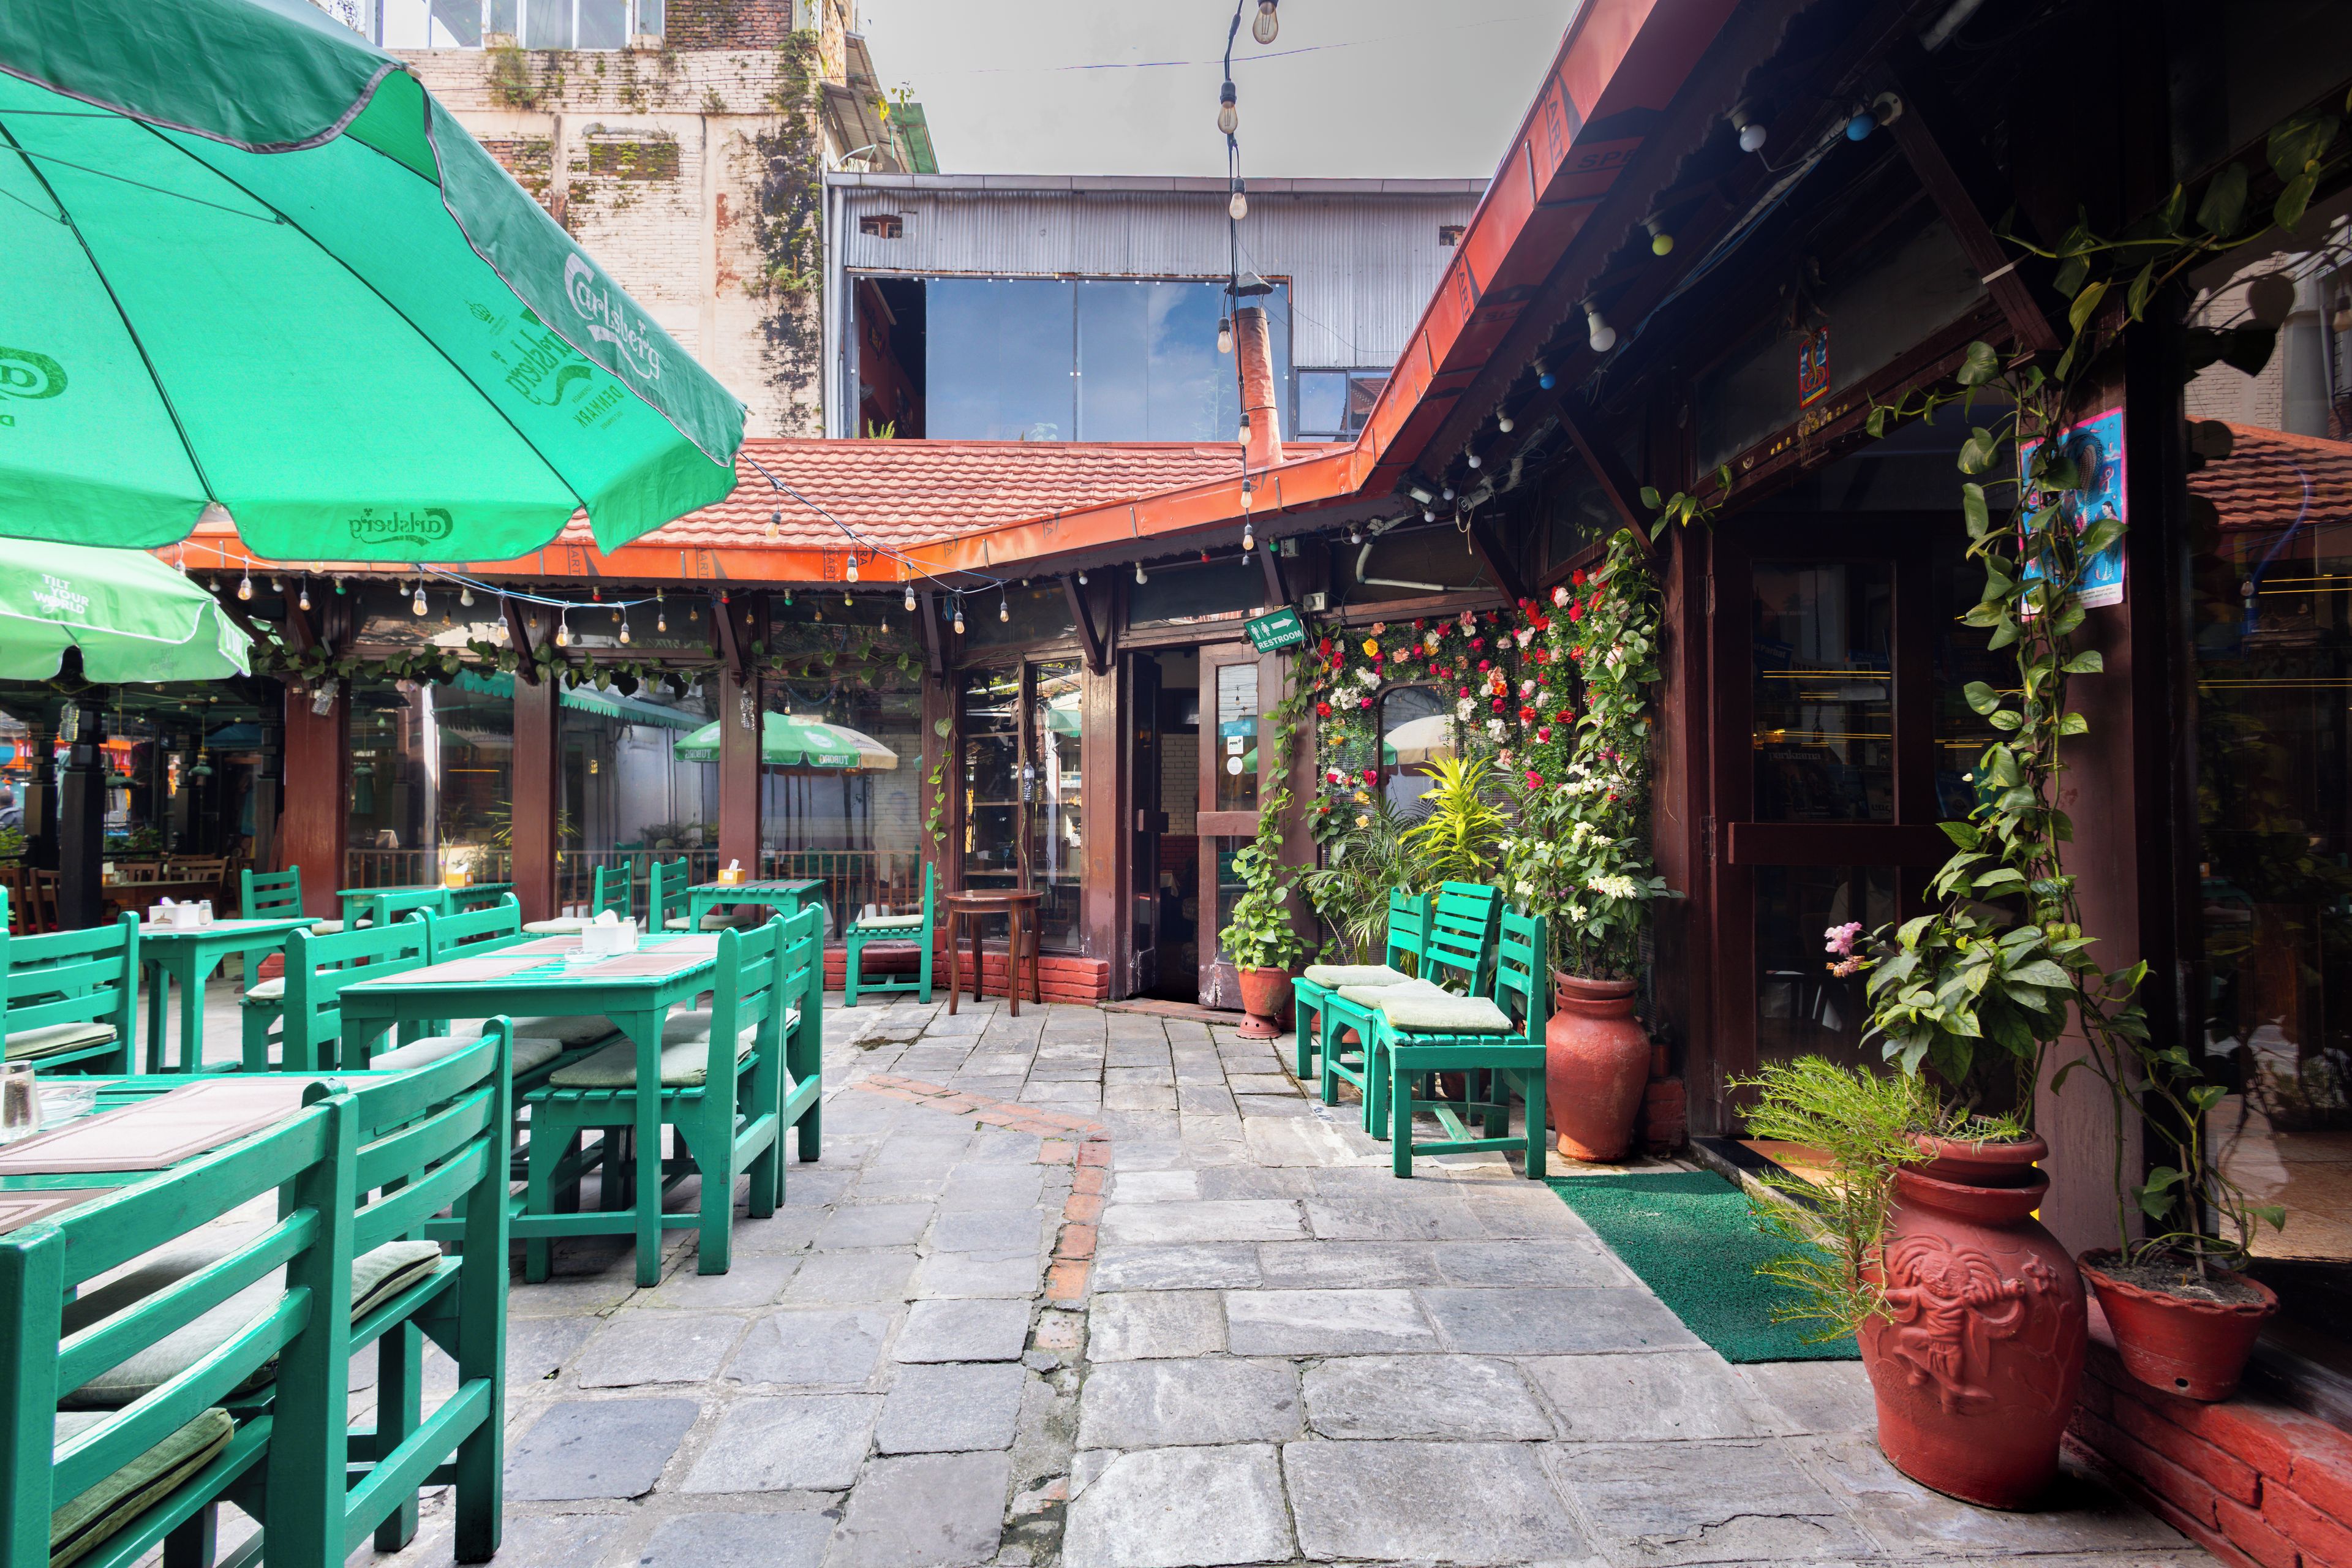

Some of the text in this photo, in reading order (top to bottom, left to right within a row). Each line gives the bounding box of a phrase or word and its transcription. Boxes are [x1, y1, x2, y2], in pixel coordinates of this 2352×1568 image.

[564, 252, 661, 380] Carlsberg
[41, 573, 70, 590] TILT
[50, 586, 89, 606] YOUR
[1257, 630, 1303, 650] RESTROOM
